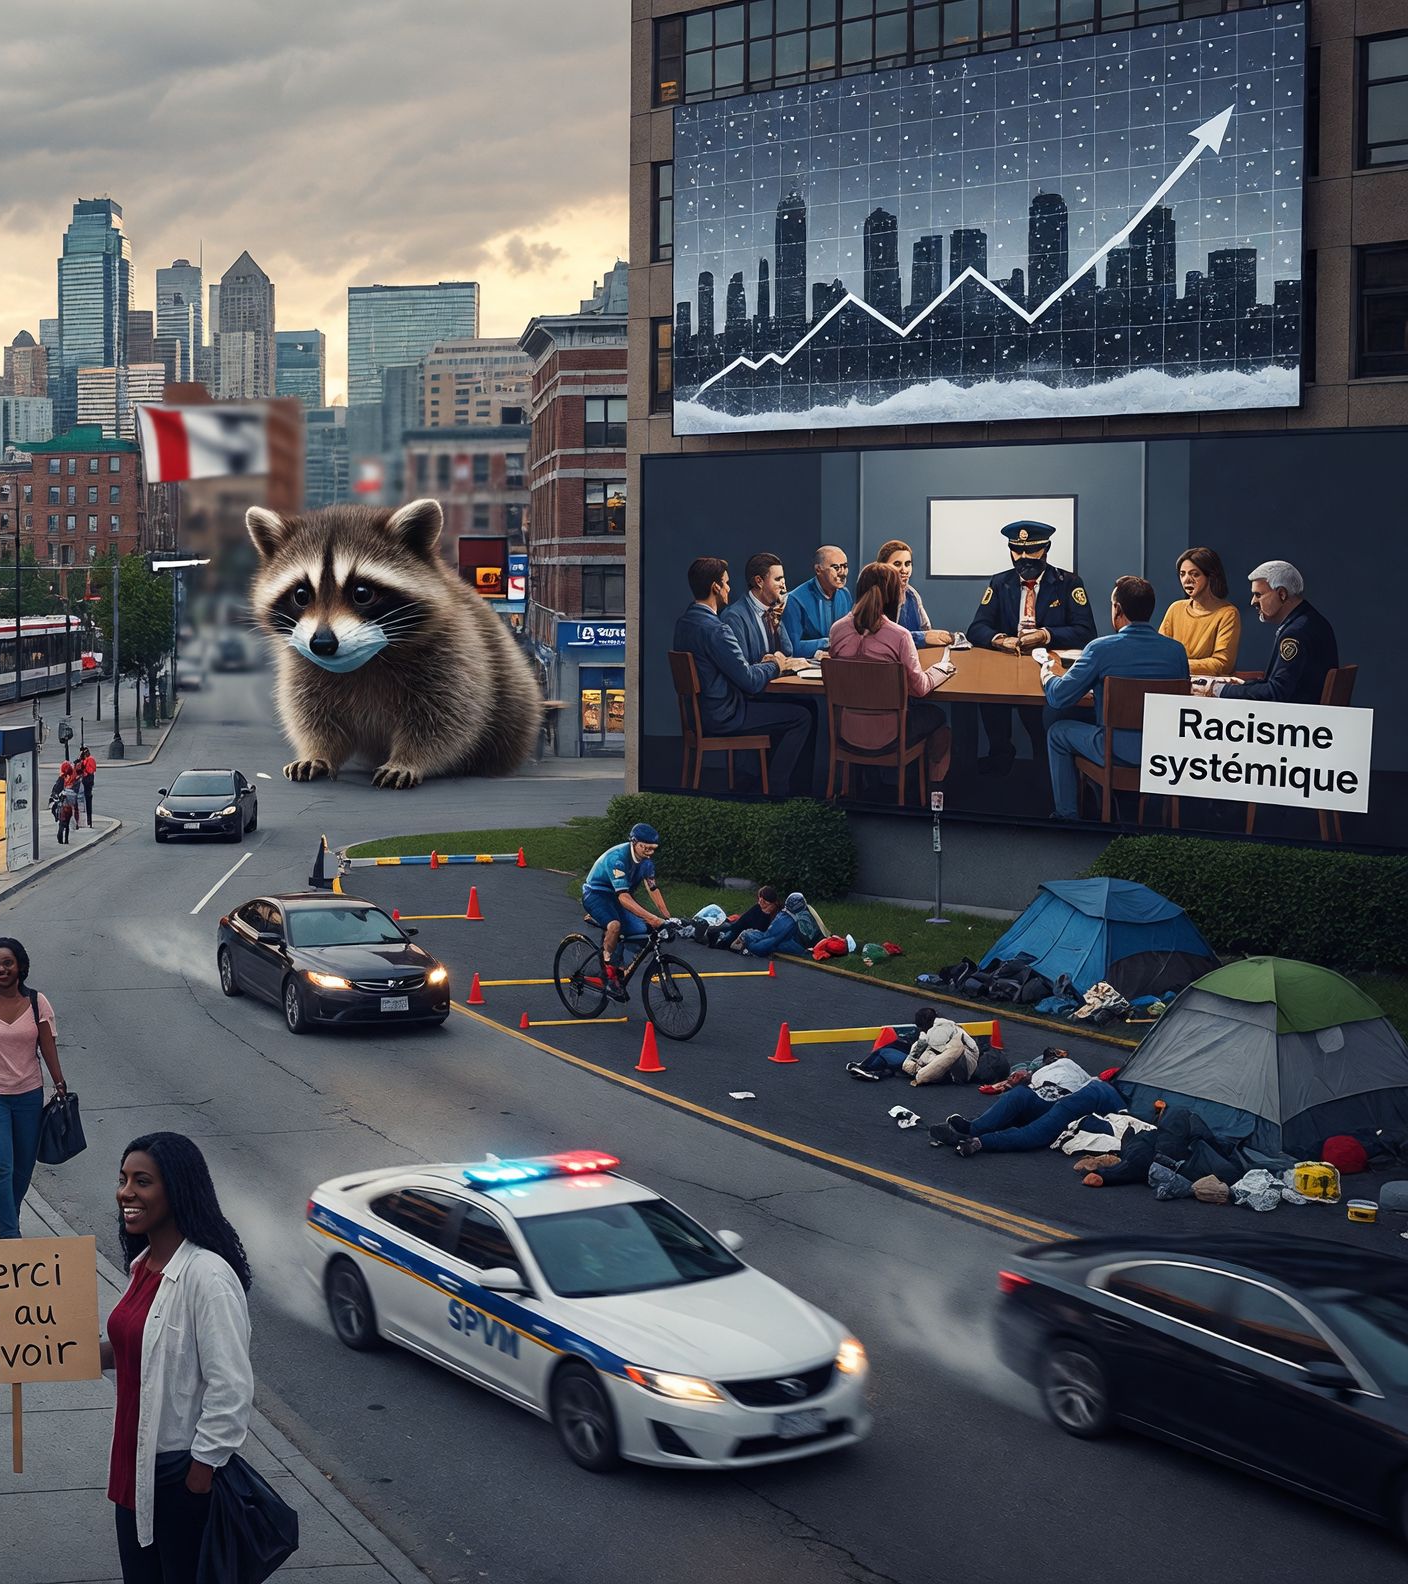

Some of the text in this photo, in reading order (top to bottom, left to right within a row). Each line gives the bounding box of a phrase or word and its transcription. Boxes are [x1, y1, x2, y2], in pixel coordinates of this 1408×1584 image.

[1177, 707, 1335, 751] Racisme
[1147, 752, 1360, 799] systémique
[13, 1303, 57, 1327] au
[447, 1297, 522, 1360] SPVM
